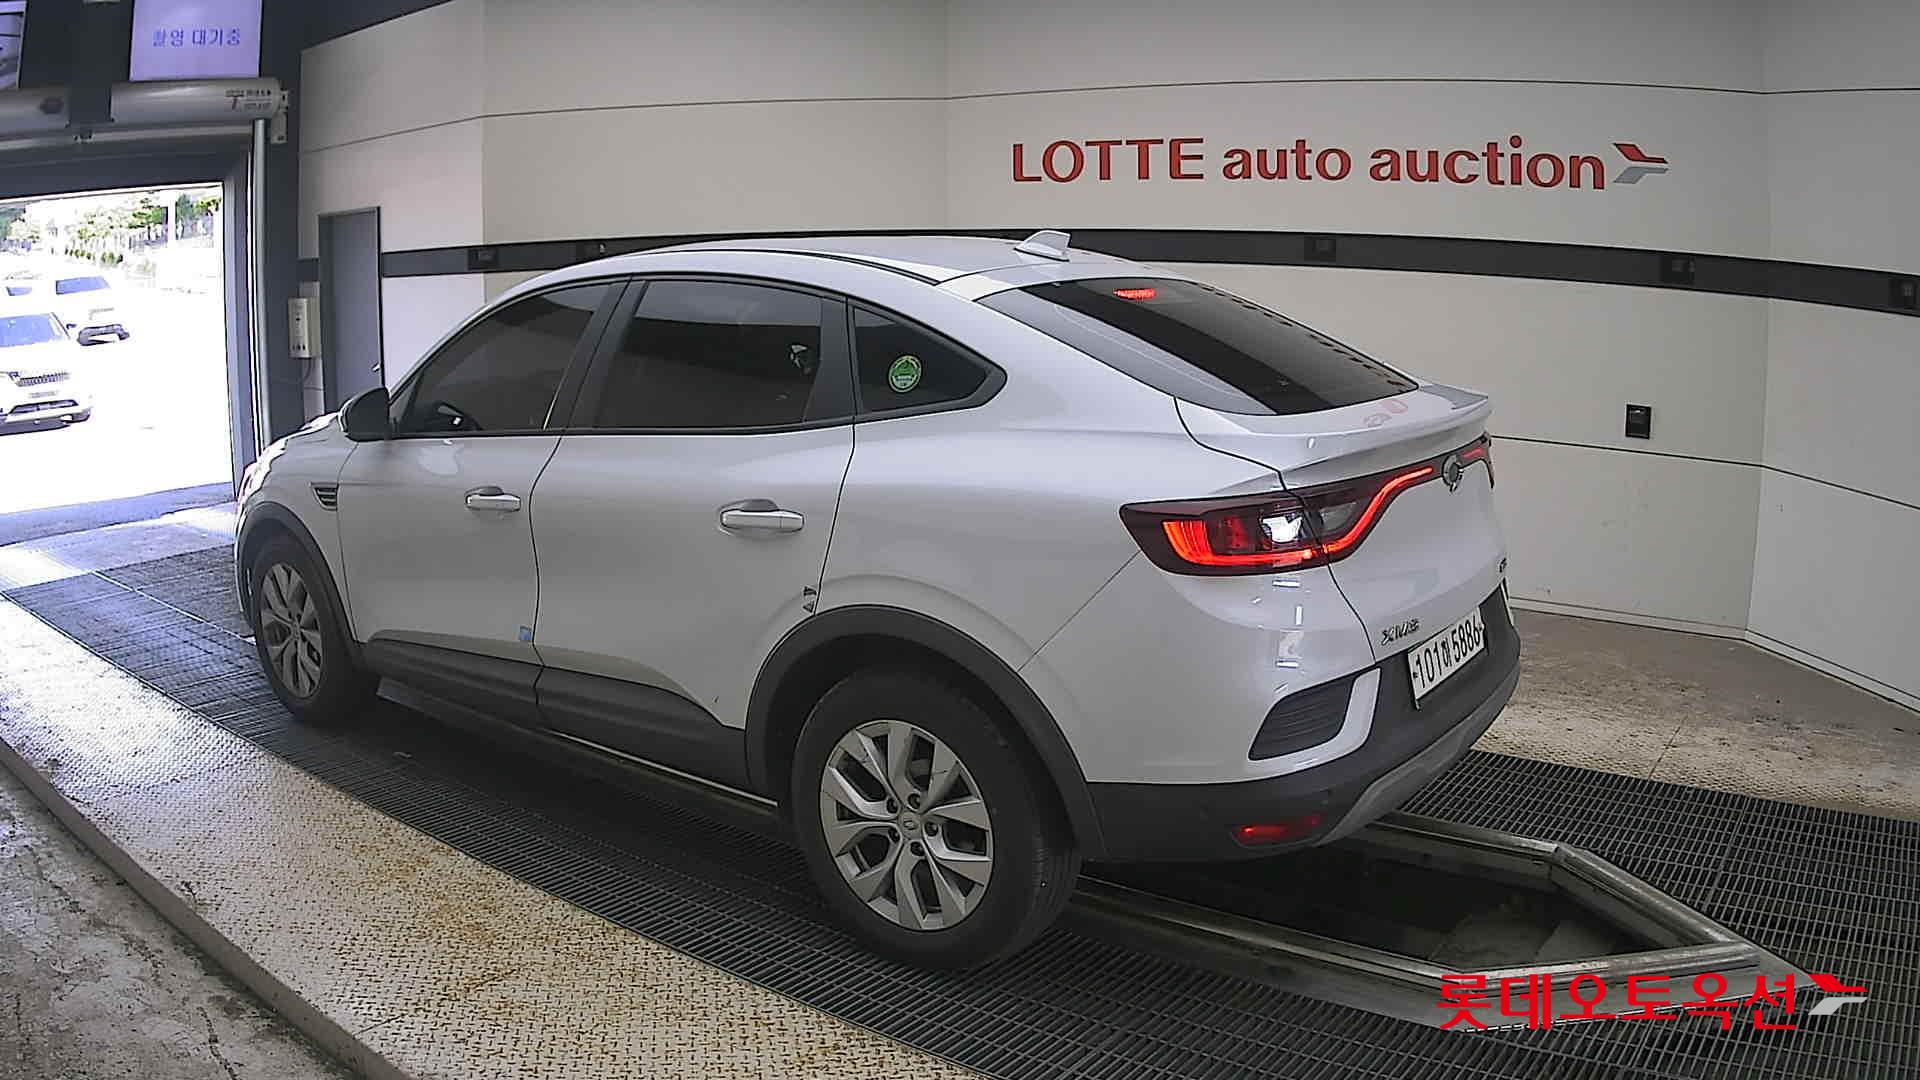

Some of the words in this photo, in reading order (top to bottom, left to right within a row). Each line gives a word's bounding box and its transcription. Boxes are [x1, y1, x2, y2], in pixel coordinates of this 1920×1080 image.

[192, 28, 241, 46] 대기중
[1012, 138, 1204, 183] LOTTE
[1223, 138, 1352, 182] auto
[1370, 136, 1606, 189] auction
